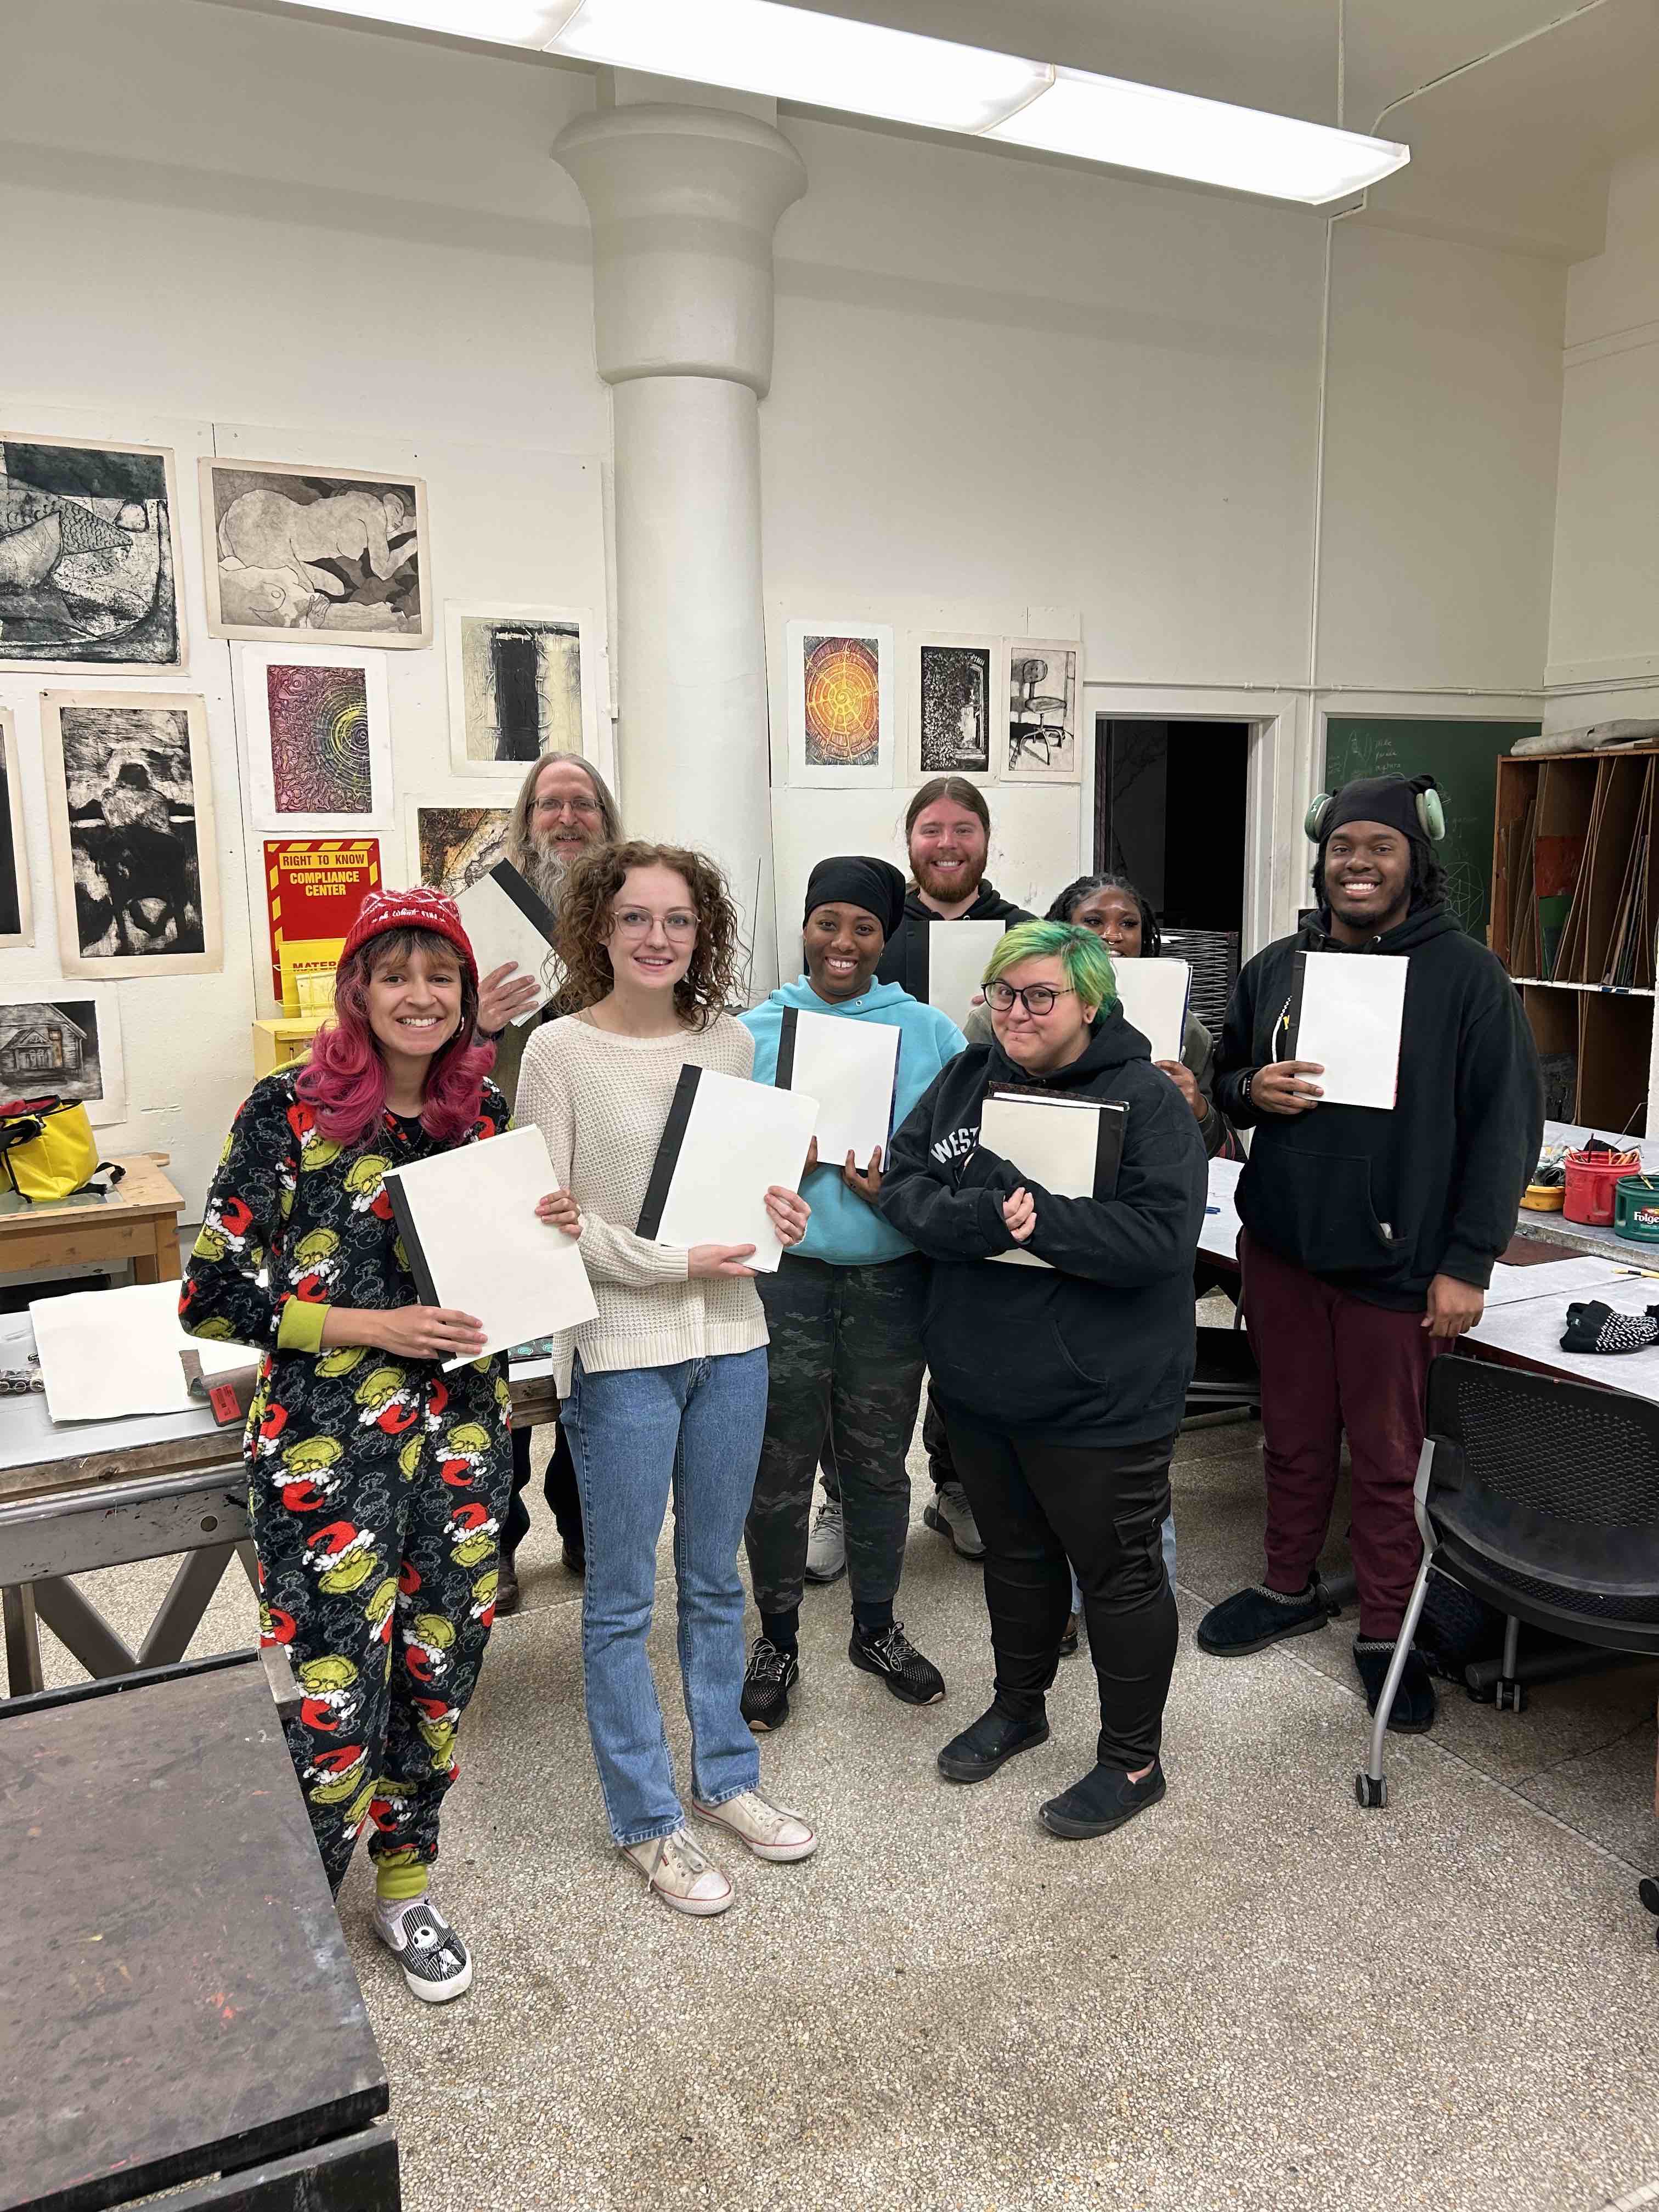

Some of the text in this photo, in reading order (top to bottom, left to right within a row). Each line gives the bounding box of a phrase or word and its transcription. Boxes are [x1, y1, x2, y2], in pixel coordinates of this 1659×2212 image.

[283, 854, 364, 866] RIGHT TO KNOW
[290, 871, 360, 884] COMPLIANCE
[306, 884, 346, 896] CENTER
